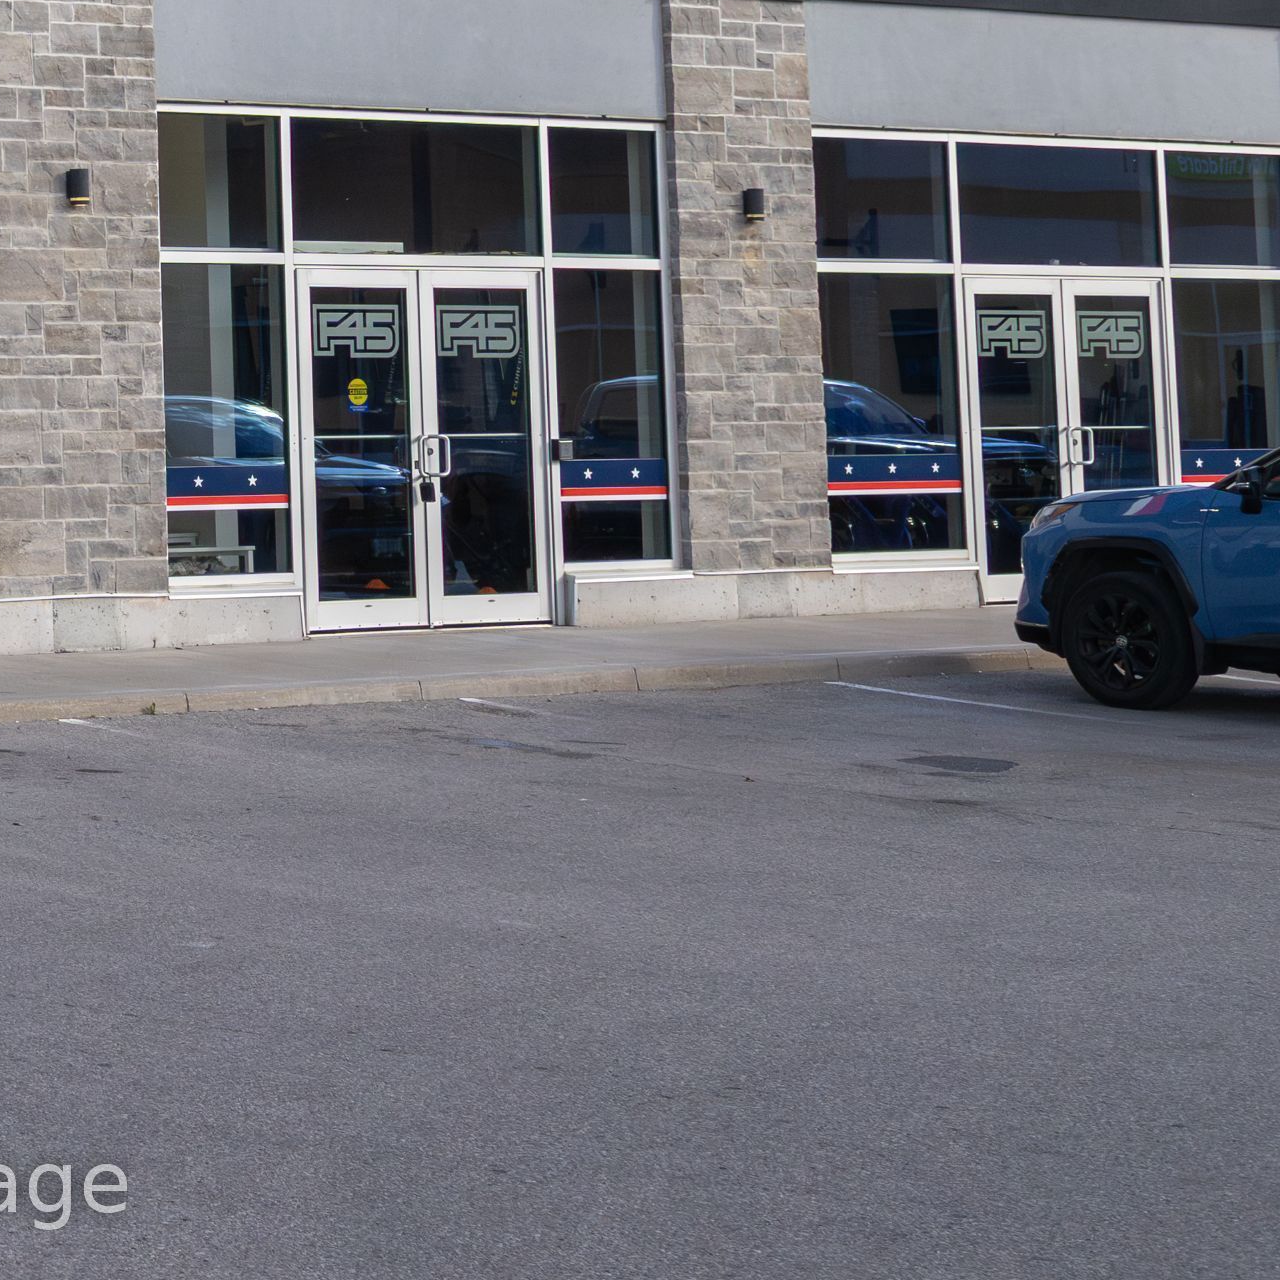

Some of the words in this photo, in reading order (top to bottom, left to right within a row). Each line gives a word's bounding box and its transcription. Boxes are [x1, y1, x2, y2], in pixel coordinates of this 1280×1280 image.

[312, 304, 400, 359] F45
[435, 304, 521, 359] F45
[976, 310, 1047, 359] F45
[1075, 310, 1145, 359] F45
